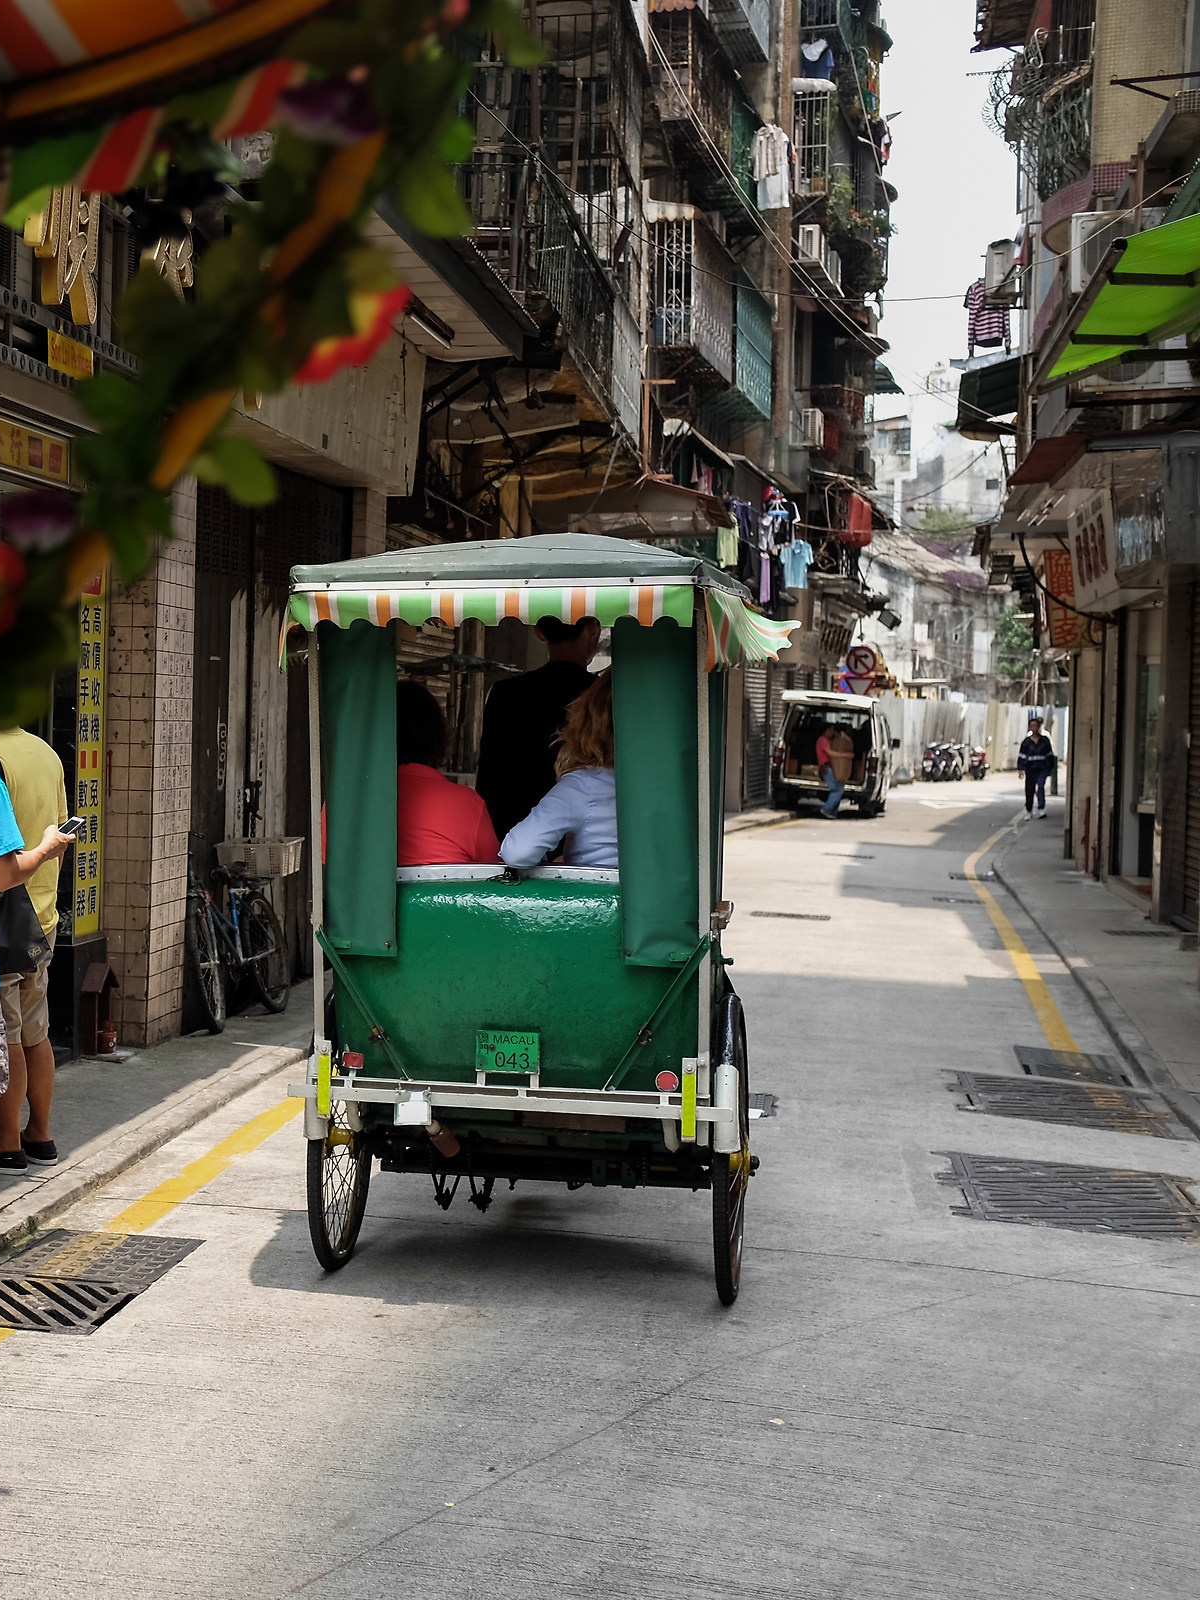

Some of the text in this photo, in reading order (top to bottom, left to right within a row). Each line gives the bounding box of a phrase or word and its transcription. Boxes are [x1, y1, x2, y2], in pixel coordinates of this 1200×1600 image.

[78, 604, 91, 743] 名廠手機
[87, 605, 102, 915] 高價收機 免費報價
[493, 1034, 535, 1046] MACAU
[494, 1051, 530, 1069] 043
